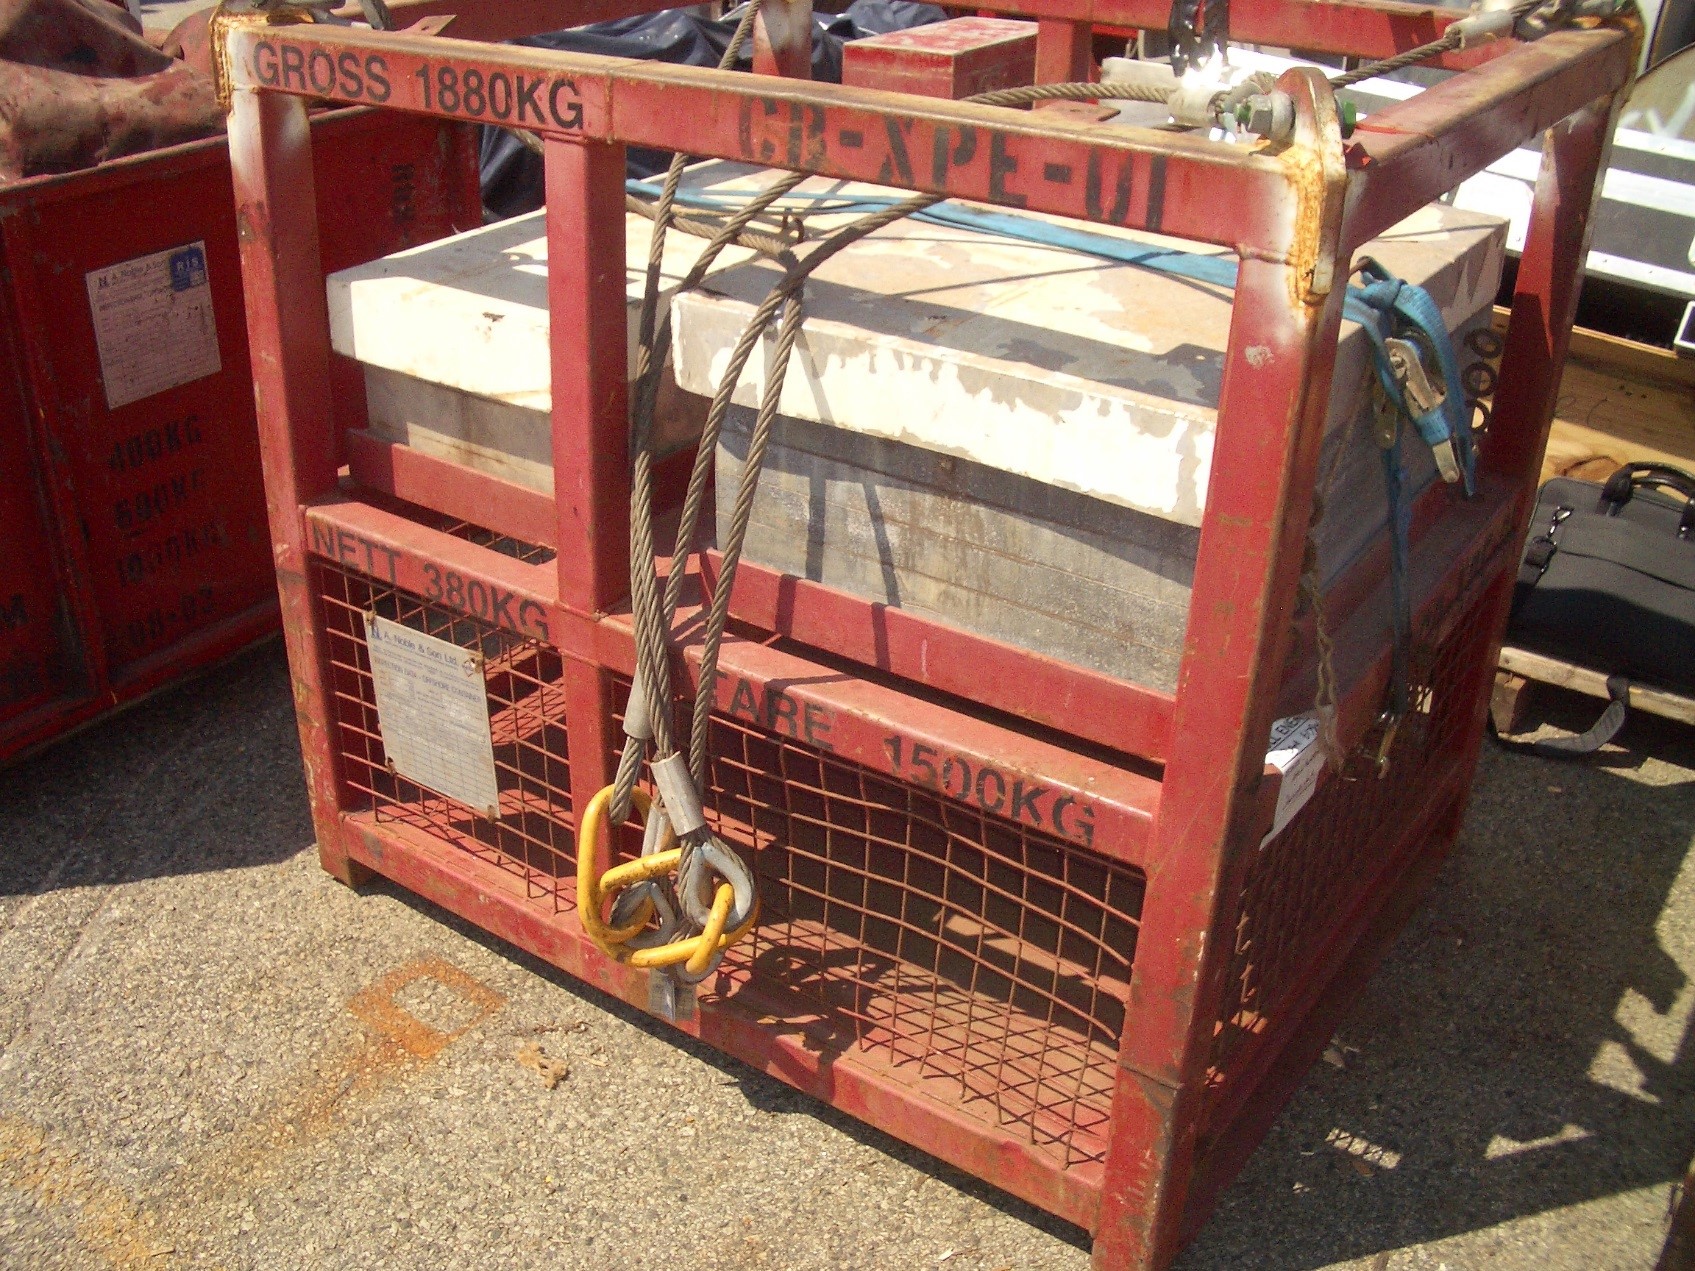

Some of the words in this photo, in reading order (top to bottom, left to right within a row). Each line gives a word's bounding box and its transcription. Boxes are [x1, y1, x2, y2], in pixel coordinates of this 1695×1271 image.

[252, 40, 392, 103] GROSS
[415, 63, 585, 130] 1880KG
[311, 516, 401, 584] NETT
[422, 562, 549, 641] 380KG
[883, 734, 1095, 848] 1500KG
